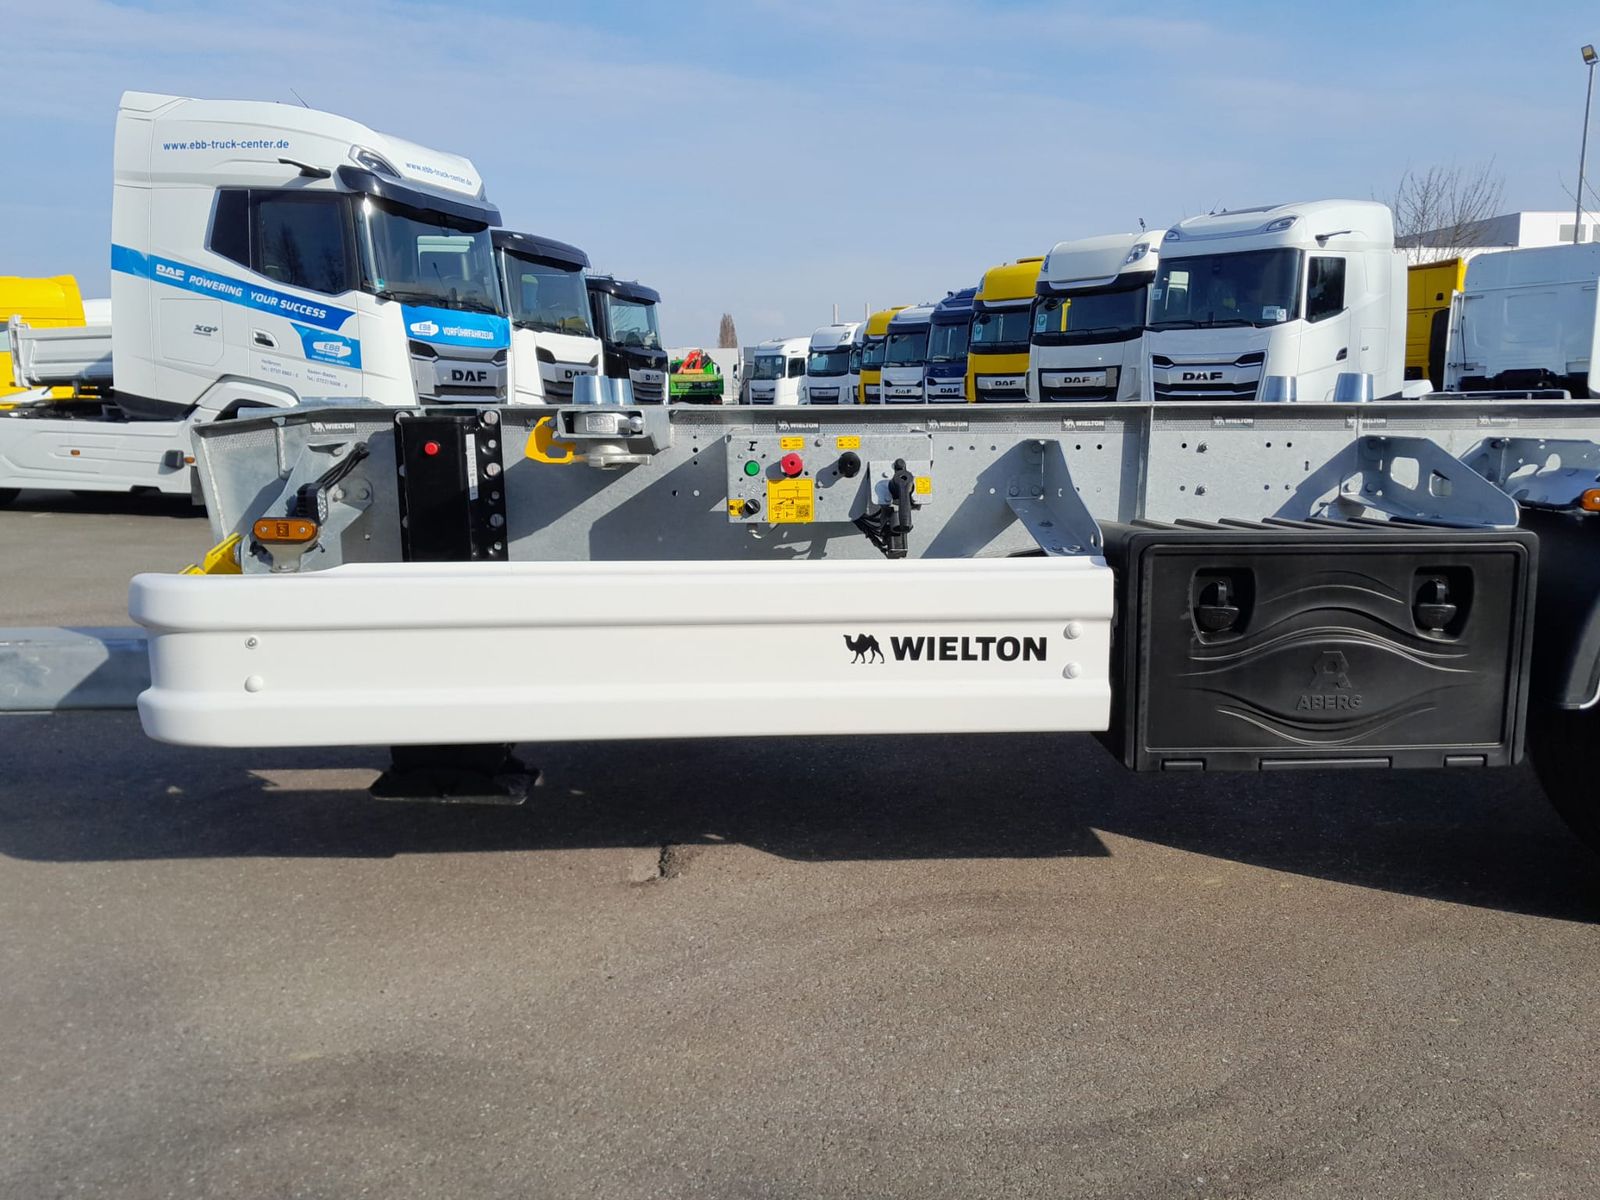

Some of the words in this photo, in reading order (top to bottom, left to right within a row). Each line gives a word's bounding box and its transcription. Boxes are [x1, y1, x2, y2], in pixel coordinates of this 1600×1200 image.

[163, 139, 290, 150] www.ebb-truck-center.de
[156, 263, 185, 278] DAF
[189, 275, 243, 298] POWERING
[250, 291, 279, 307] YOUR
[279, 299, 327, 319] SUCCESS
[323, 343, 341, 353] EBB
[451, 369, 488, 382] DAF
[1063, 376, 1091, 384] DAF
[1182, 371, 1224, 381] DAF
[324, 422, 355, 430] WIELTON
[889, 636, 1048, 662] WIELTON
[1295, 694, 1363, 711] ABERG
